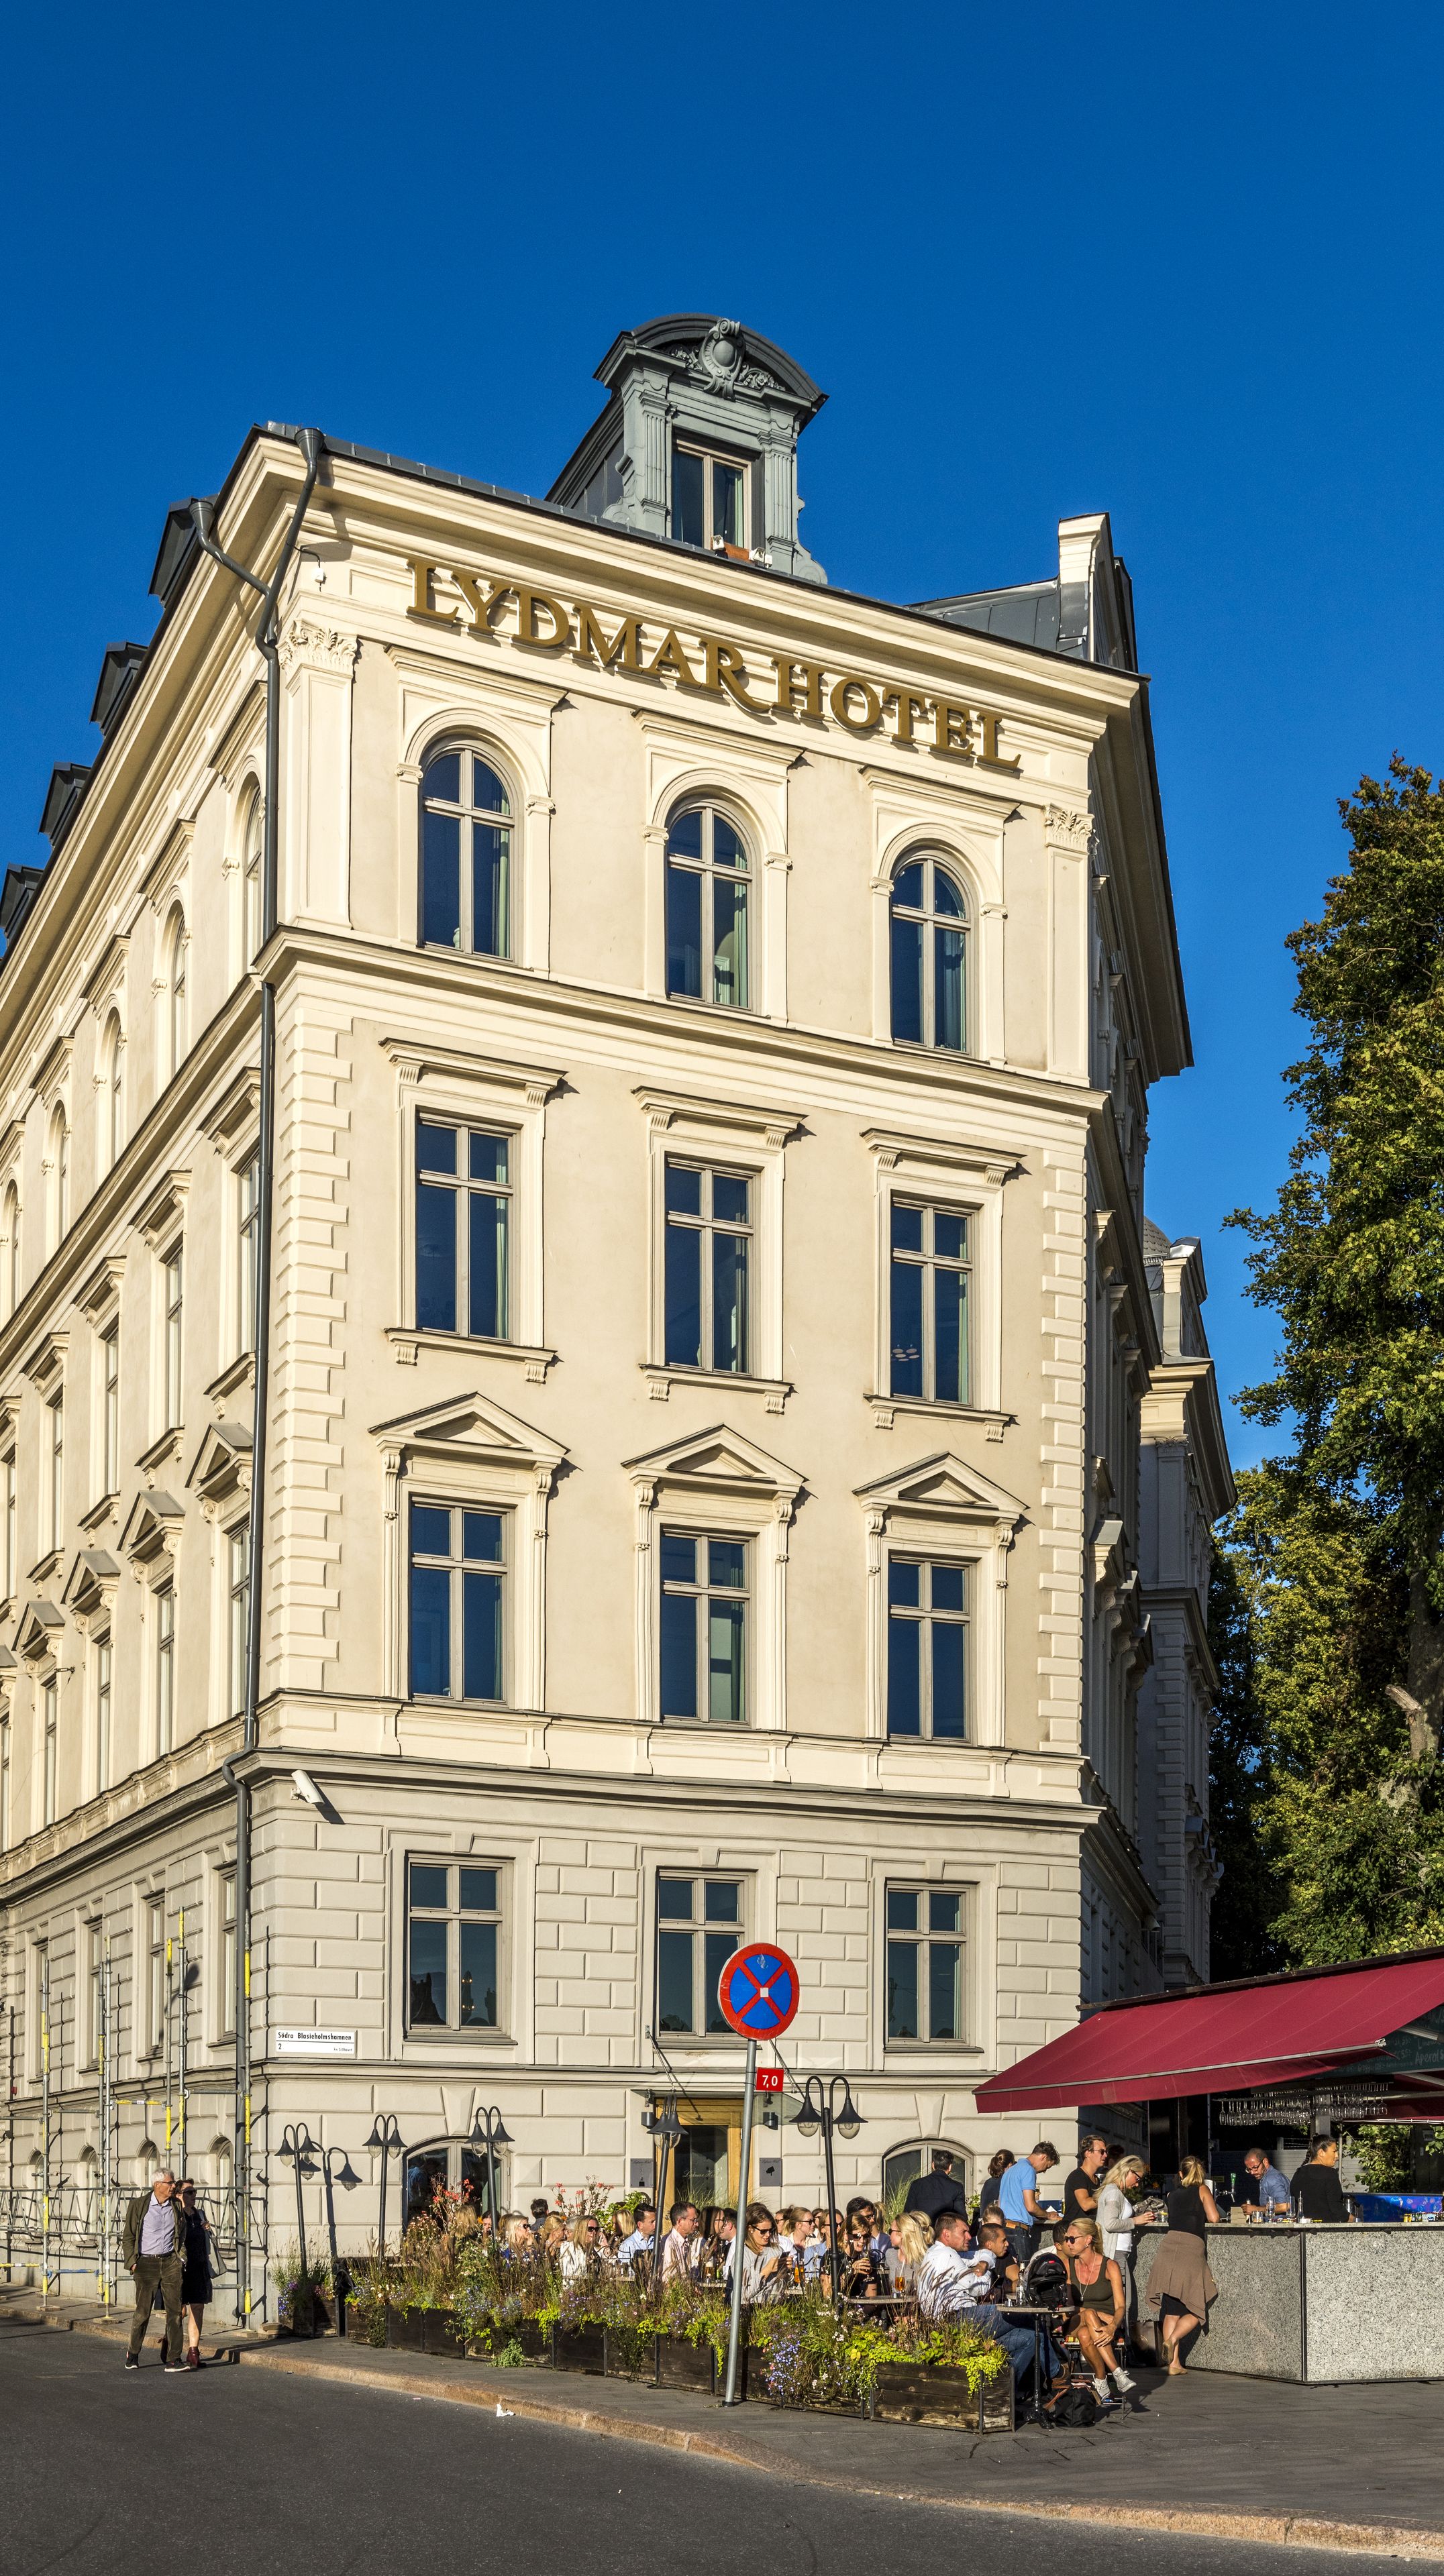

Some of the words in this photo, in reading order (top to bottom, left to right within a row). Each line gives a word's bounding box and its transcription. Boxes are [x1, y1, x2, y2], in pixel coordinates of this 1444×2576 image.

[404, 558, 772, 715] LYDMAR
[770, 657, 1021, 773] HOTEL
[1415, 2049, 1439, 2065] Aperol
[762, 2075, 778, 2088] 7,0
